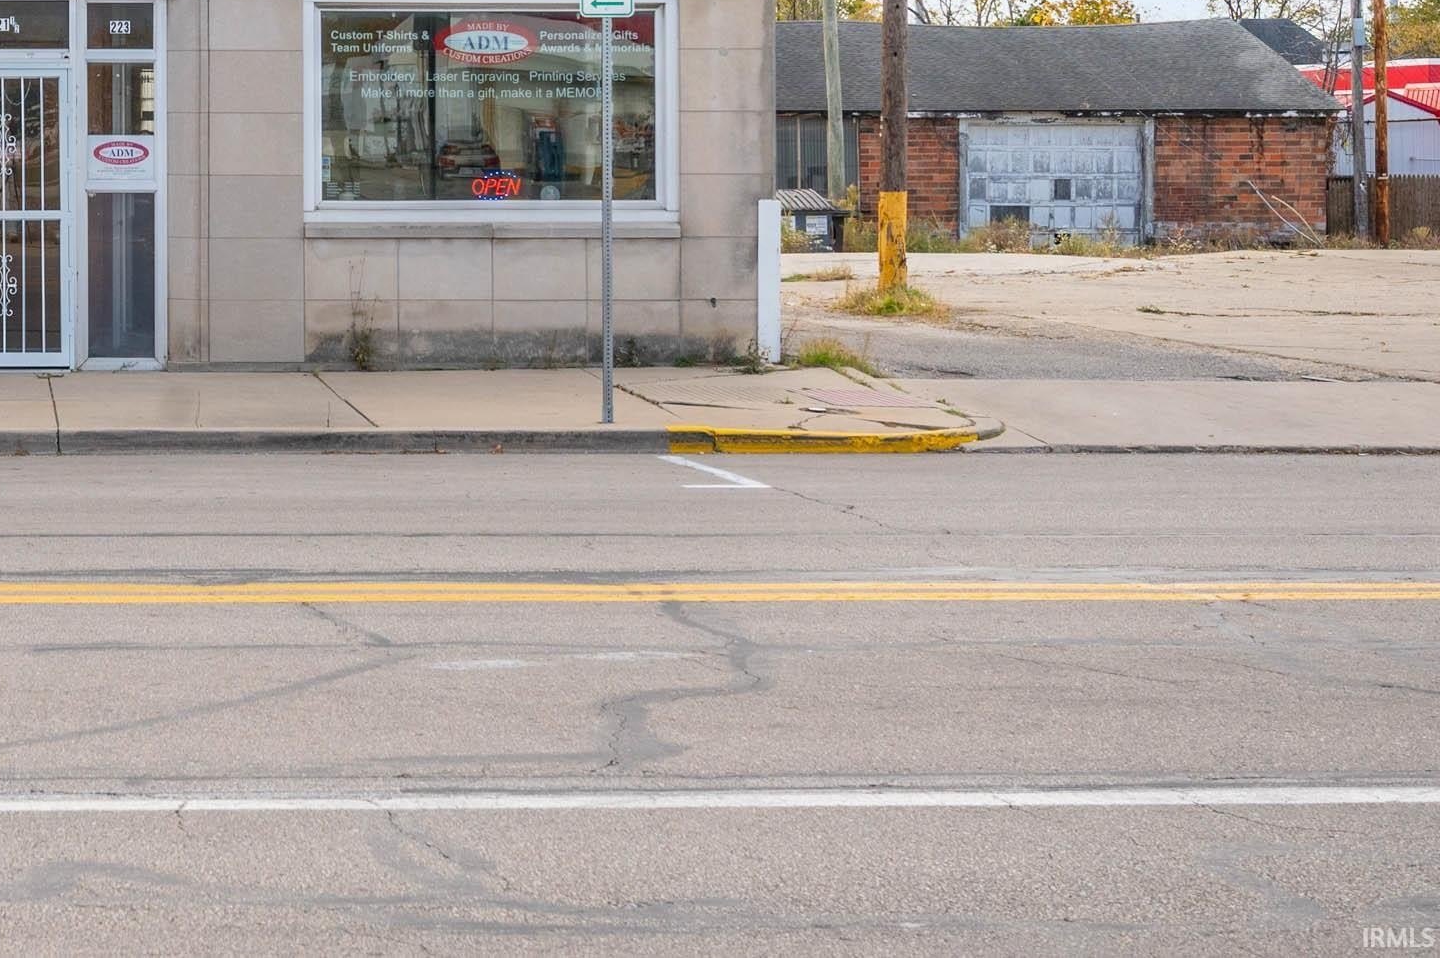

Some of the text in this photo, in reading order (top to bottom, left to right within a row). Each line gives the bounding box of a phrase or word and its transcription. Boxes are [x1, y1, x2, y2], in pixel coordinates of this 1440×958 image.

[110, 21, 130, 33] 223
[467, 23, 510, 31] MADE BY
[330, 30, 430, 40] Custom T-Shirts &
[540, 30, 639, 40] Personalize Gifts
[331, 43, 413, 53] Team Uniforms
[464, 35, 509, 50] ADM
[540, 43, 651, 53] Awards & Mmorials
[443, 48, 533, 64] CUSTOM CREATIONS
[350, 70, 627, 84] Embroidery Laser Engraving Printing Serves
[361, 87, 393, 98] Make
[406, 89, 435, 98] more
[438, 87, 464, 98] than
[467, 90, 474, 98] a
[478, 87, 498, 100] gift,
[500, 87, 532, 98] make
[536, 87, 543, 98] it
[545, 90, 553, 98] a
[556, 87, 602, 98] MEMO
[109, 148, 134, 157] ADM
[471, 178, 522, 196] OPEN
